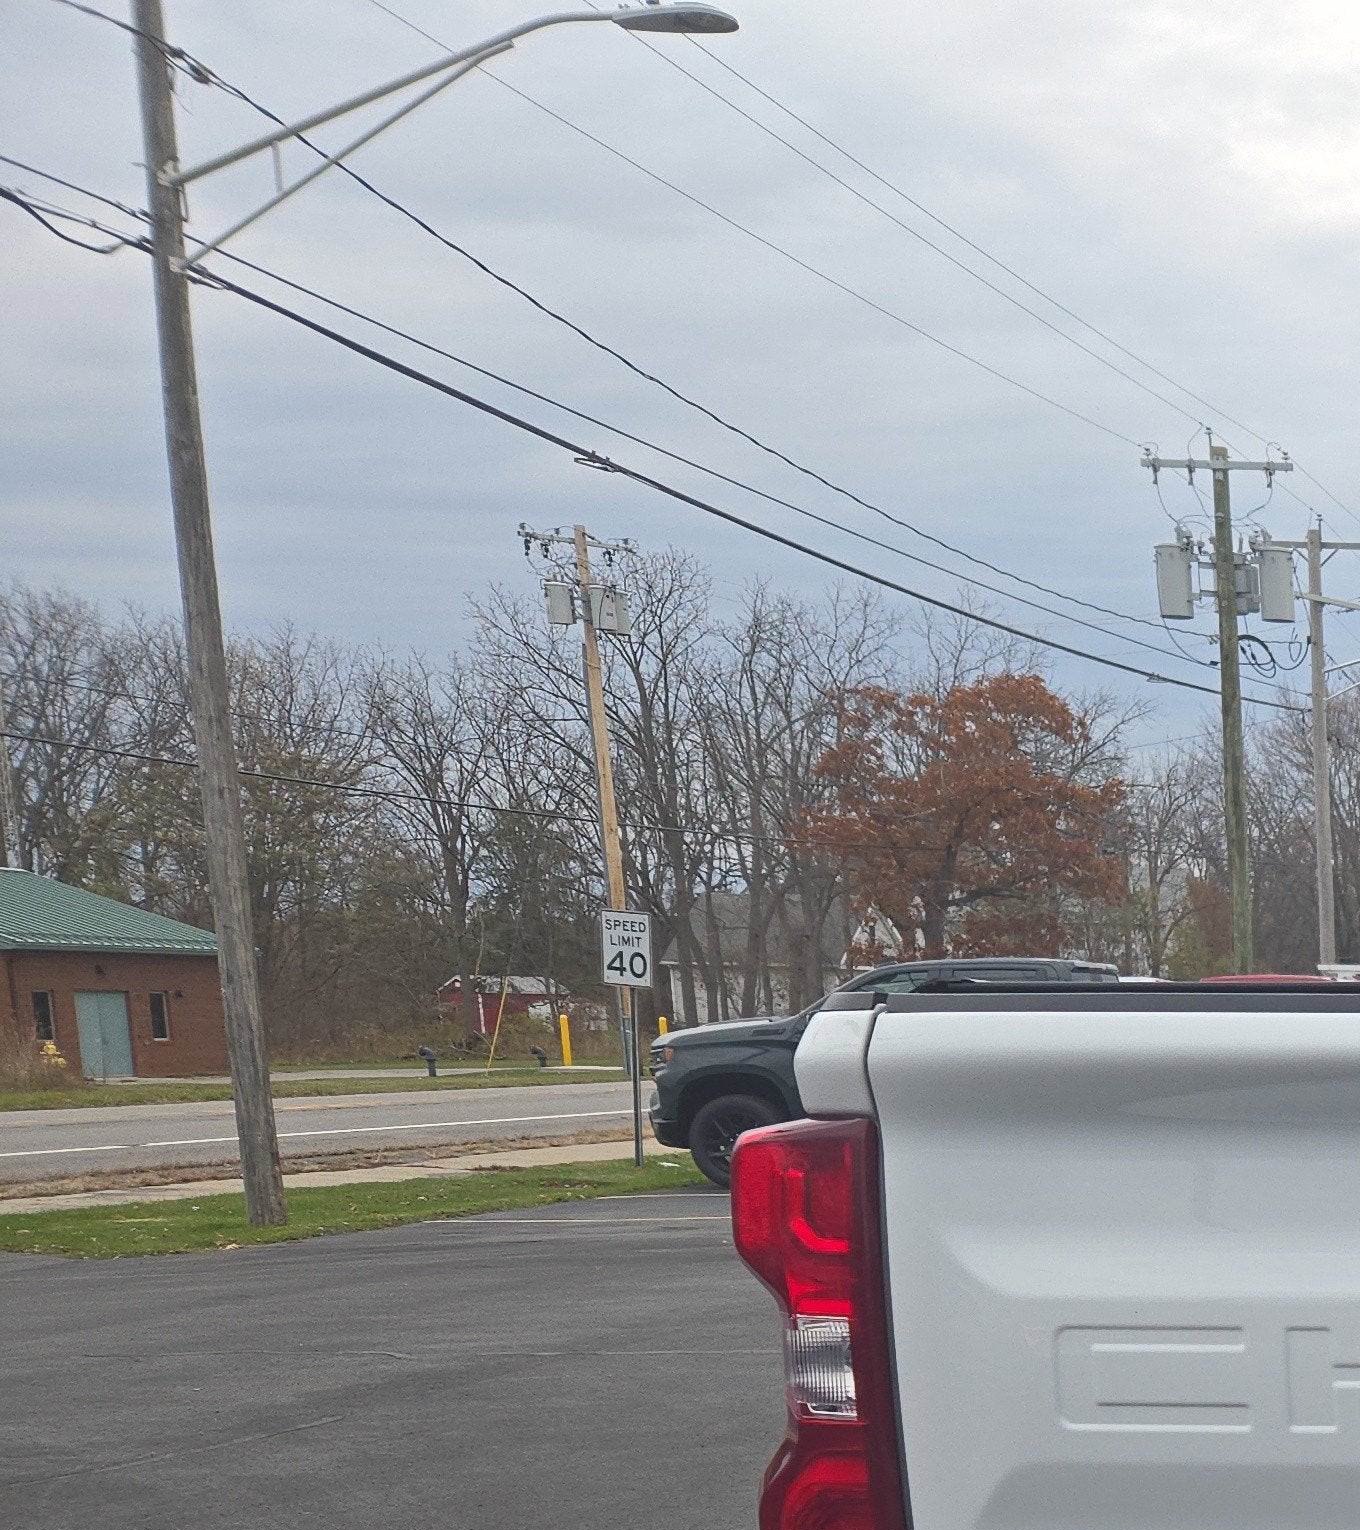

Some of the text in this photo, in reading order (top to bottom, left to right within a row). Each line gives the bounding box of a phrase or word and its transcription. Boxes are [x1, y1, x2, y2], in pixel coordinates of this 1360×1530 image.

[605, 919, 646, 933] SPEED
[610, 934, 642, 948] LIMIT
[607, 951, 647, 978] 40
